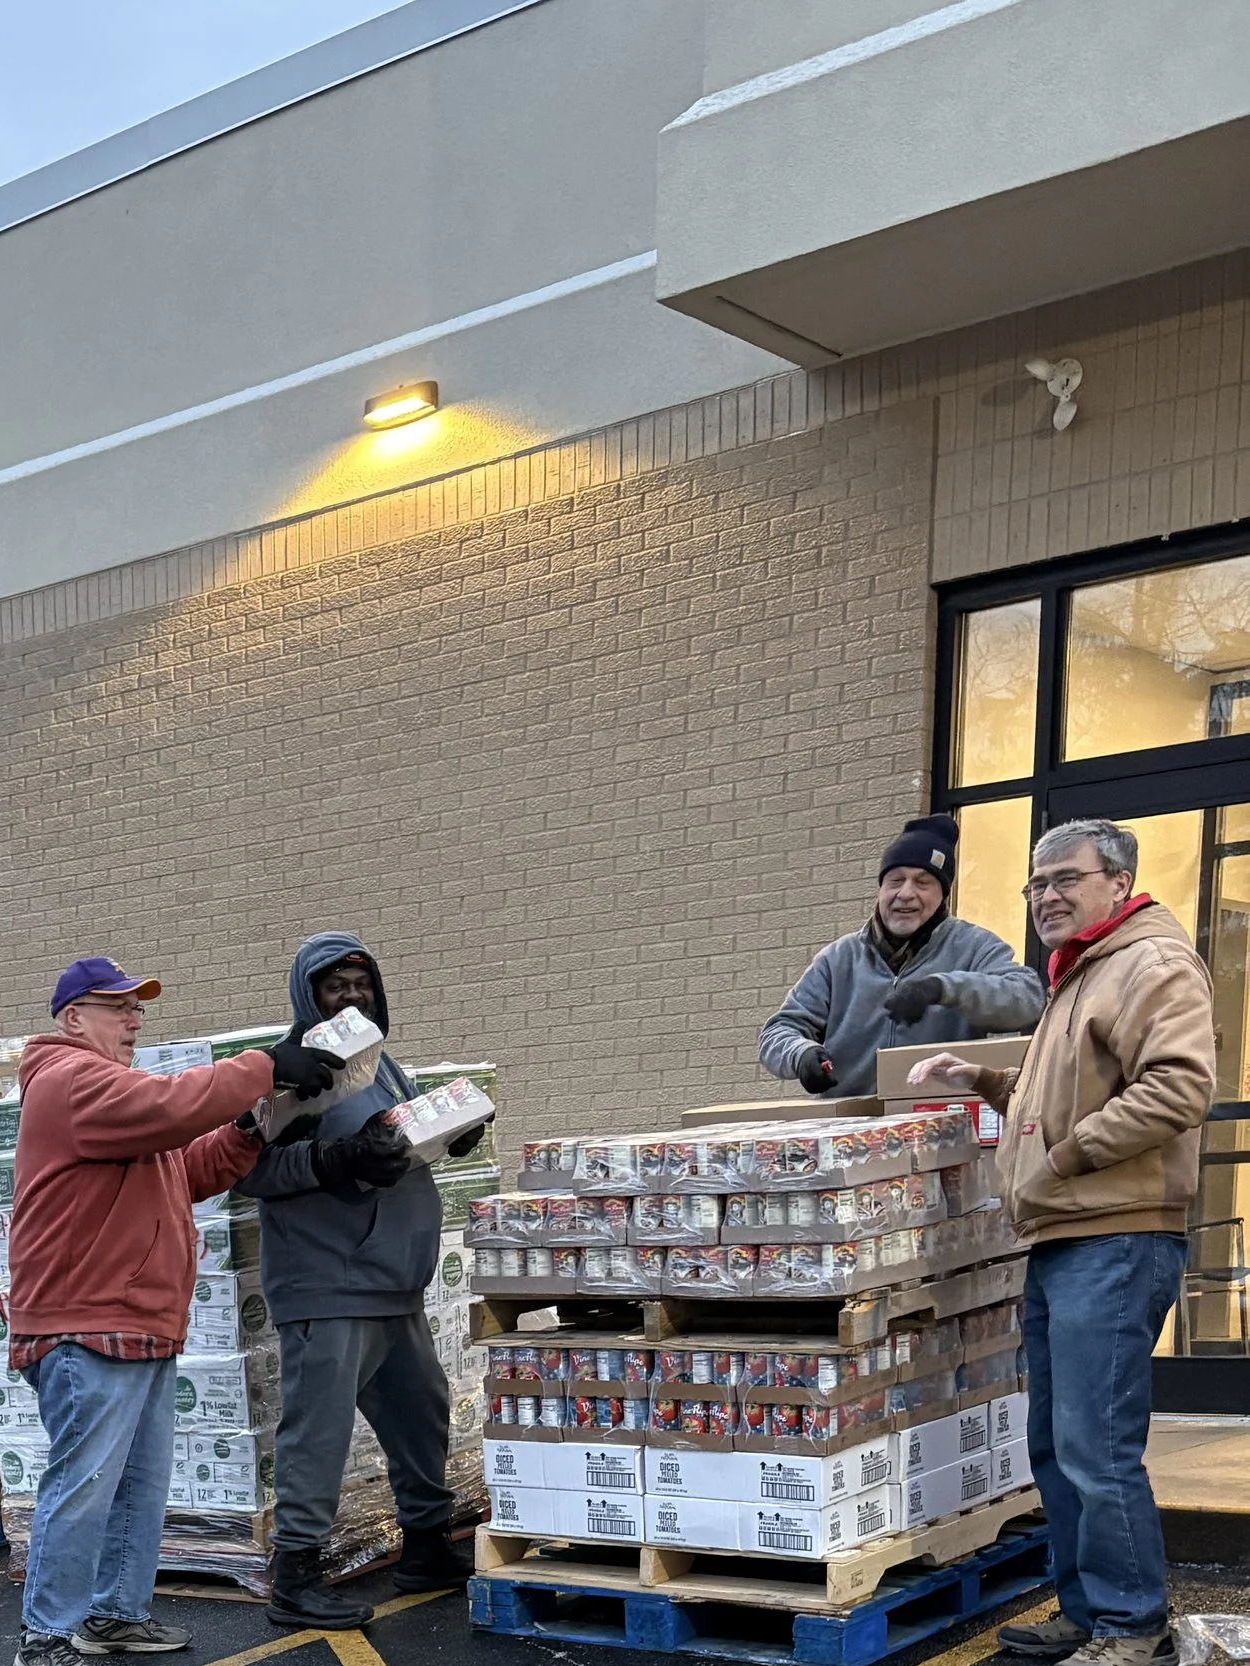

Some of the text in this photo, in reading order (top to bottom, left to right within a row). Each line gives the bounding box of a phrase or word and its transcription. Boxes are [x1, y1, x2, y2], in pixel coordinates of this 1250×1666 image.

[573, 1354, 591, 1366] Vine
[627, 1351, 644, 1366] Ripe
[200, 1400, 238, 1416] 1% Lowfat
[219, 1409, 234, 1417] Milk
[712, 1405, 729, 1419] Ripe
[496, 1454, 514, 1464] DICED
[659, 1462, 680, 1472] DICED
[26, 1473, 38, 1489] 1%
[657, 1476, 682, 1485] TOMATOES
[197, 1488, 207, 1500] 12
[263, 1491, 272, 1503] 12
[499, 1500, 516, 1510] DICED
[497, 1512, 519, 1521] TOMATOES
[658, 1511, 678, 1521] DICED
[655, 1525, 681, 1534] TOMATOES
